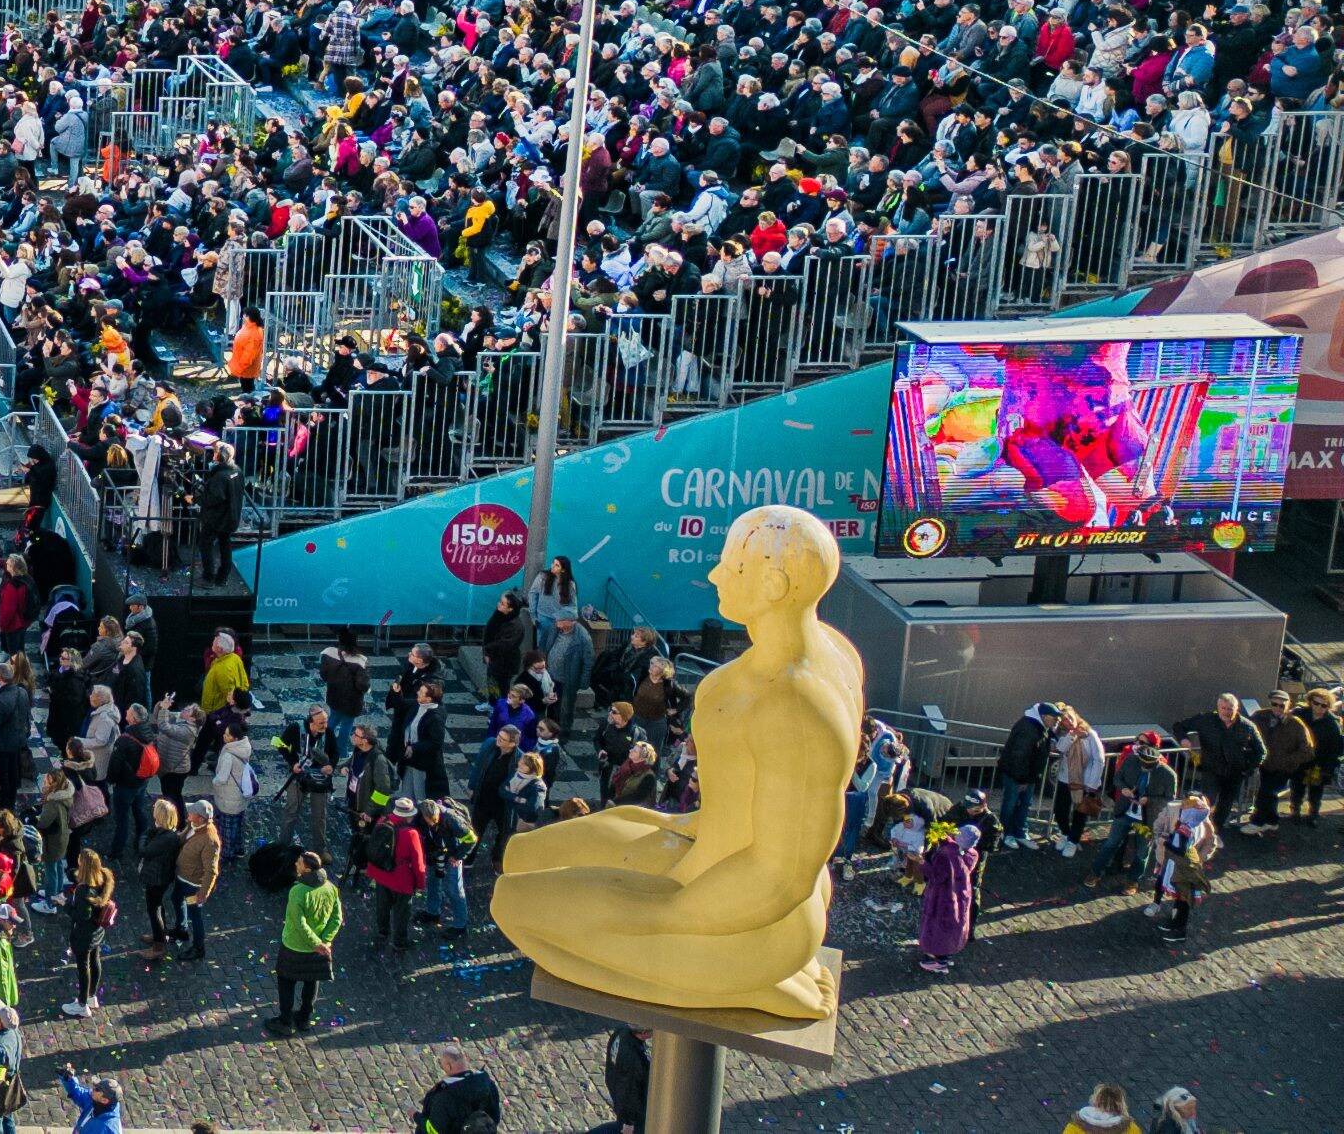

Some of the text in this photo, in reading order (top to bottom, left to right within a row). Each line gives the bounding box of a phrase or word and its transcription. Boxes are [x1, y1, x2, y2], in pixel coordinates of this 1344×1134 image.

[660, 467, 834, 509] CARNAVAL
[834, 471, 855, 491] DE
[451, 523, 524, 546] 150 ANS
[654, 519, 673, 532] du
[680, 518, 704, 537] 10
[446, 540, 521, 572] Majesté
[668, 548, 703, 564] ROI
